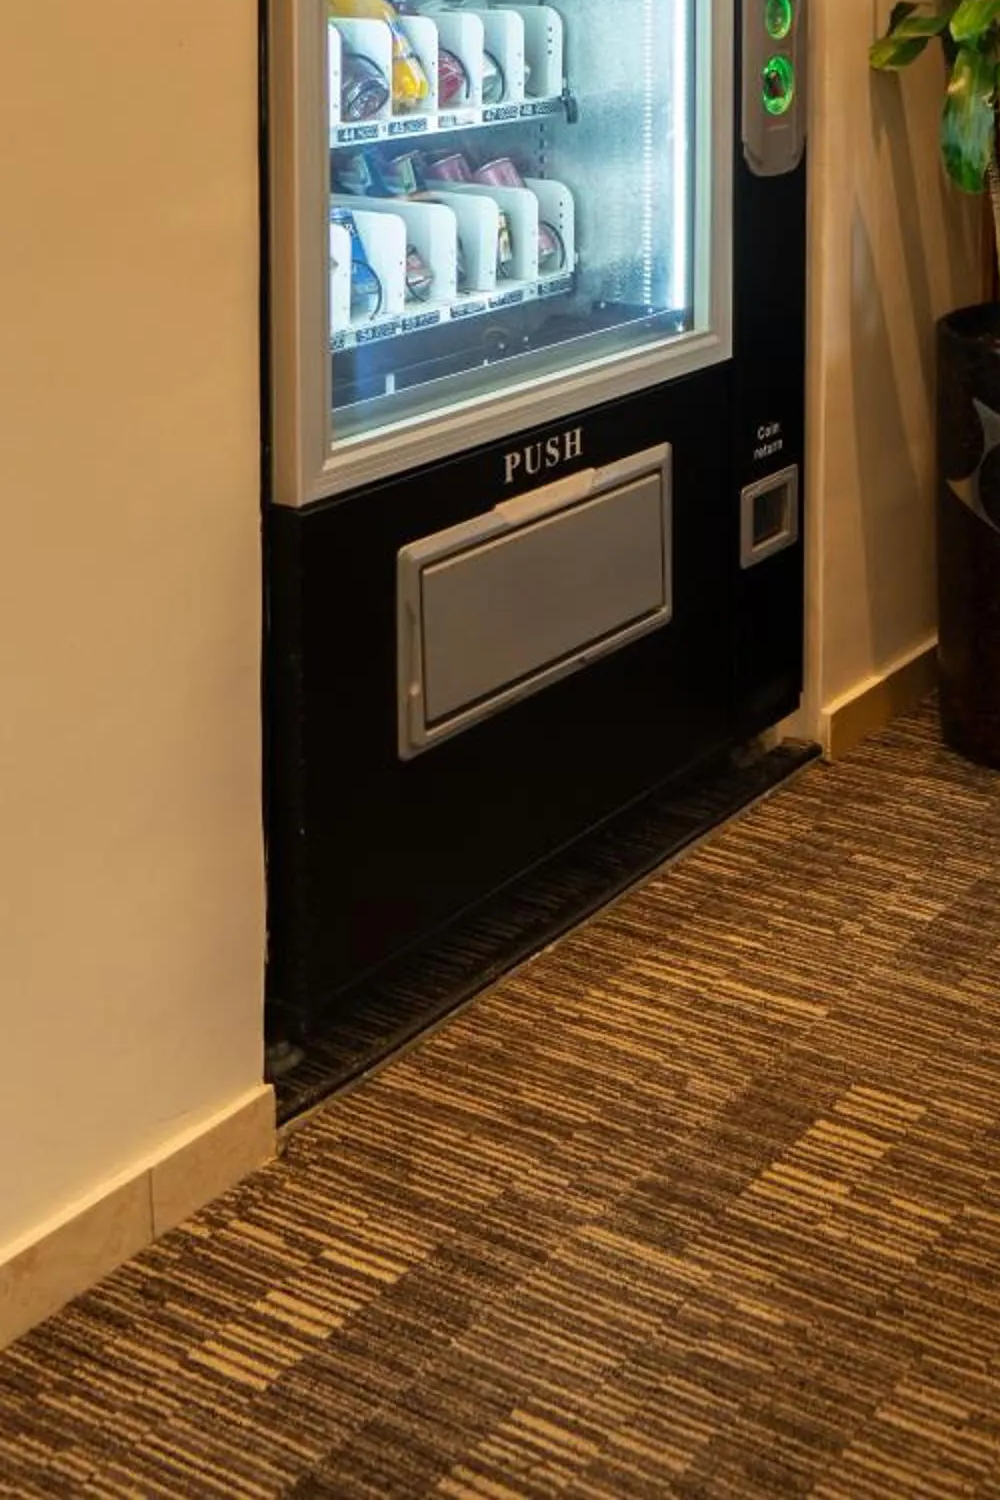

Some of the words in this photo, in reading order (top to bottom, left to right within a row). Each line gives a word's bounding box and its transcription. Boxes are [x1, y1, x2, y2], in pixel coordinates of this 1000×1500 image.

[757, 422, 780, 440] Coin
[503, 427, 583, 485] PUSH
[753, 440, 783, 460] return
